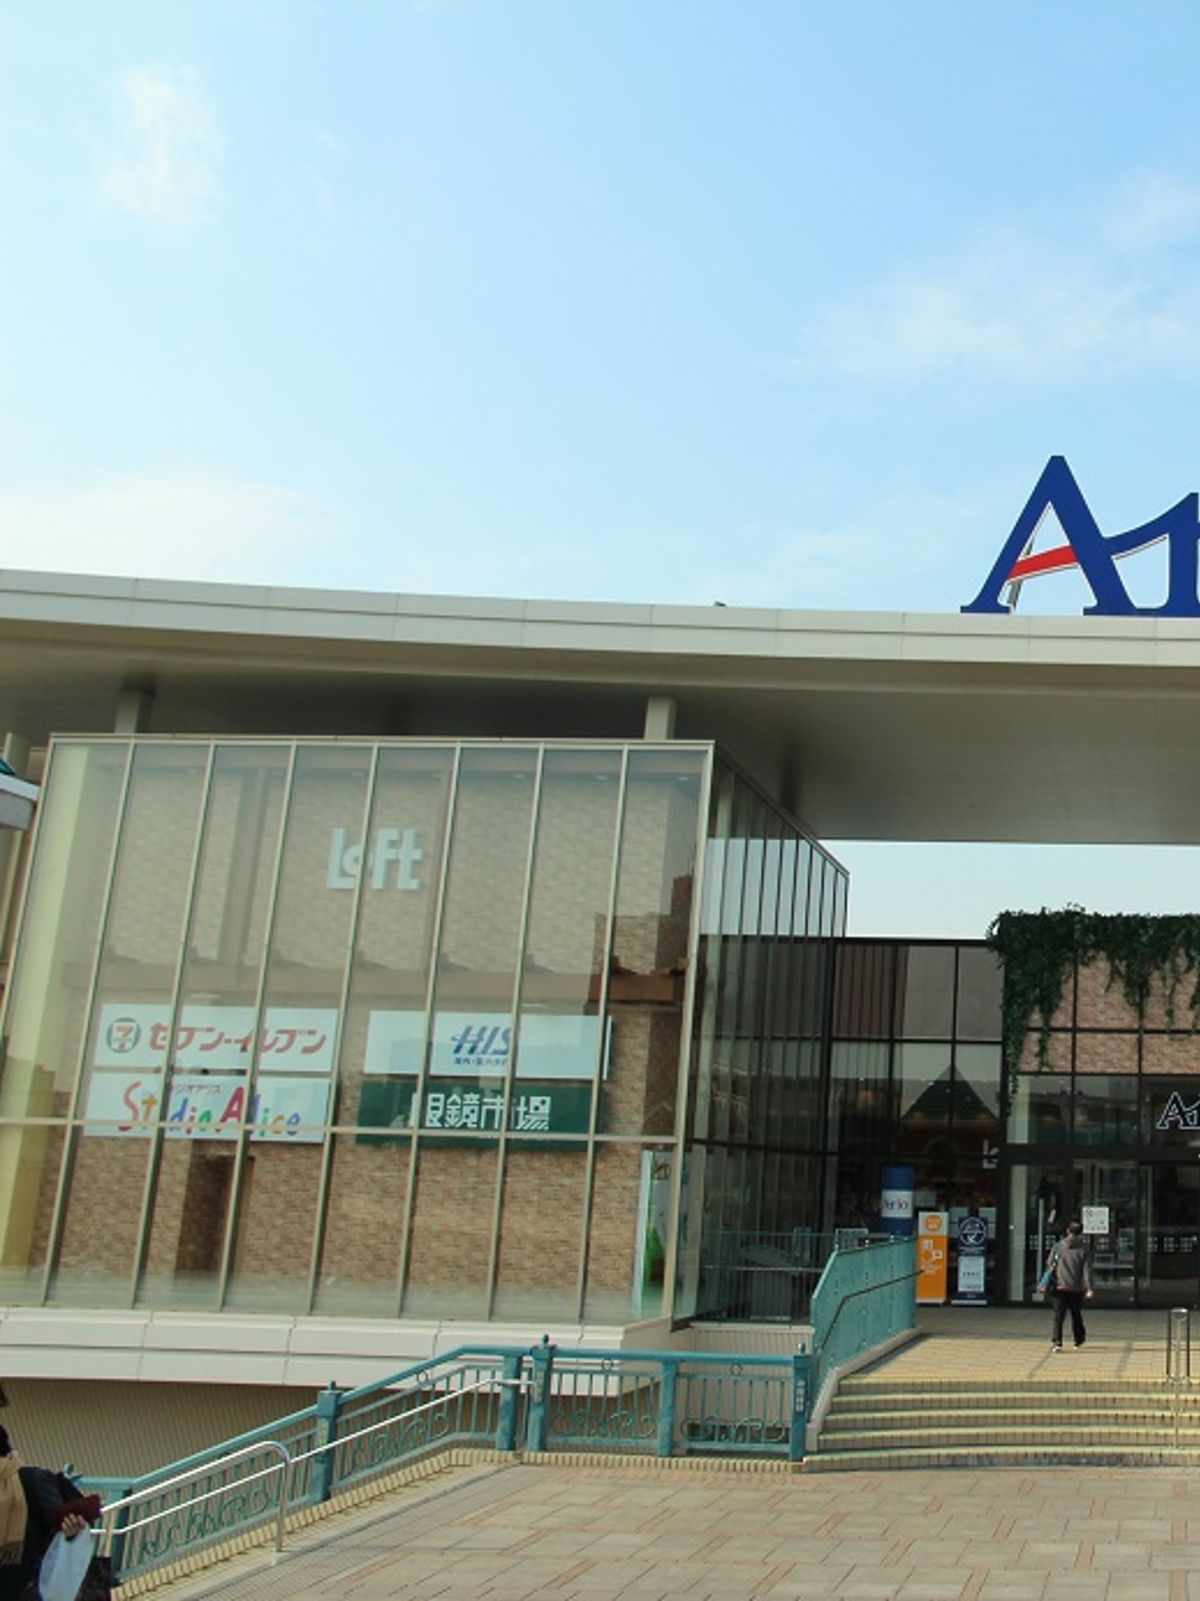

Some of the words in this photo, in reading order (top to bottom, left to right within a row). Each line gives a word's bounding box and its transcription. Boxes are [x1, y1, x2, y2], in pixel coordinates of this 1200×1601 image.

[452, 1025, 513, 1055] HIS
[118, 1081, 211, 1134] Stdio
[409, 1093, 551, 1130] 眼鏡市場
